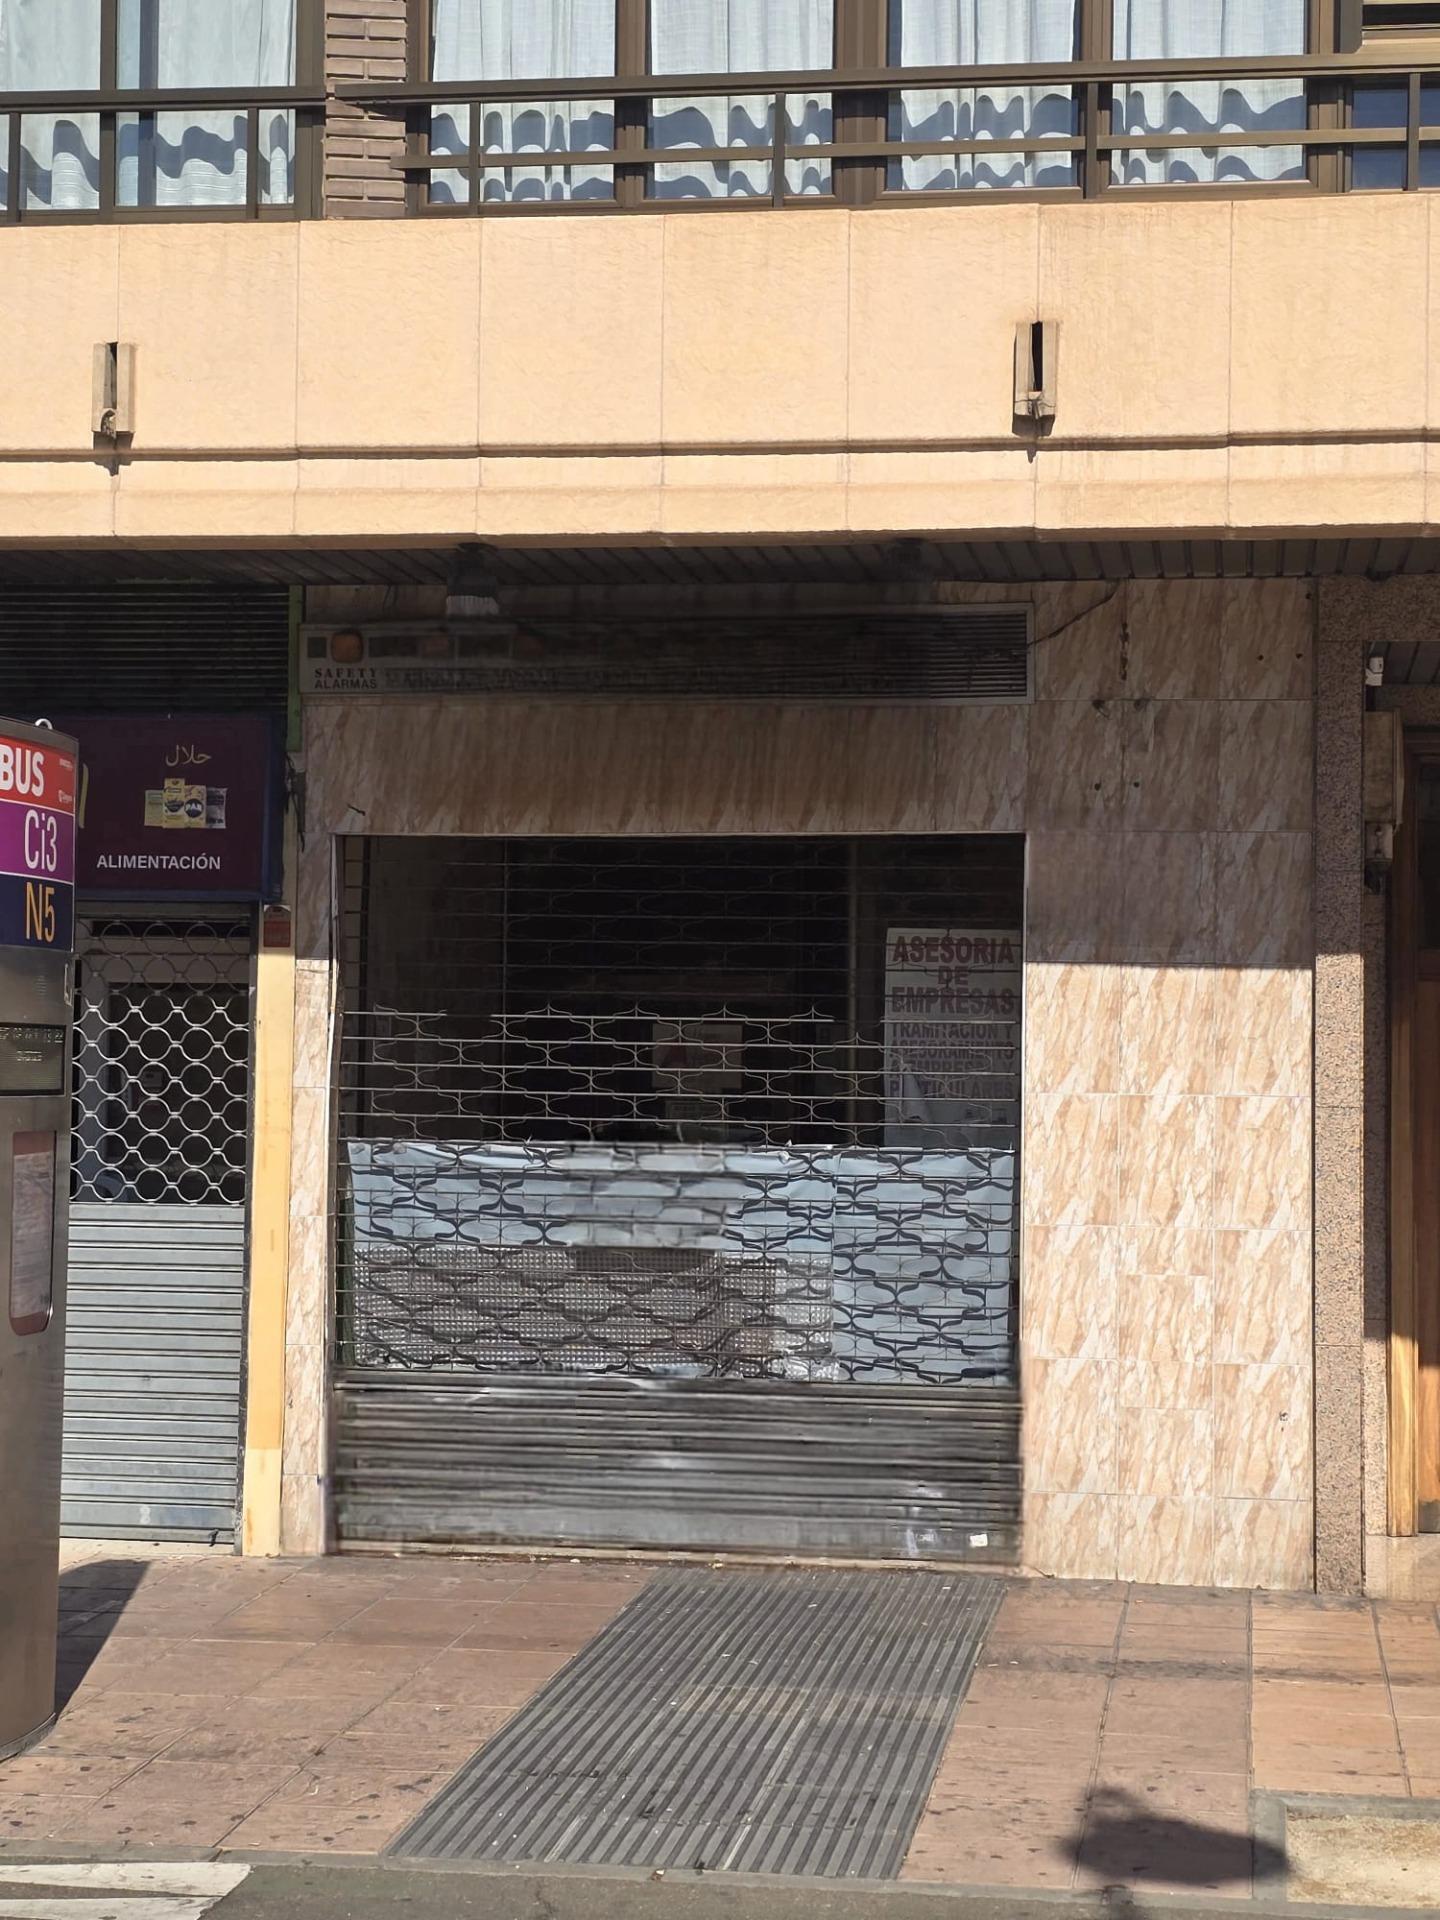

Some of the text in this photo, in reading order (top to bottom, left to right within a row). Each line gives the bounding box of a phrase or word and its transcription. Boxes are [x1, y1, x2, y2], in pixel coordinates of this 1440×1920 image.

[314, 667, 375, 679] SAFETY
[314, 679, 377, 690] ALARMAS
[165, 744, 212, 767] حلال
[0, 743, 44, 797] BUS
[24, 809, 57, 872] Ci3
[96, 853, 221, 870] ALIMENTACIÓN
[25, 881, 55, 943] N5
[892, 935, 1015, 964] ASESORIA
[938, 965, 969, 985] DE
[891, 986, 1015, 1015] EMPRESAS
[1003, 1023, 1014, 1040] Y
